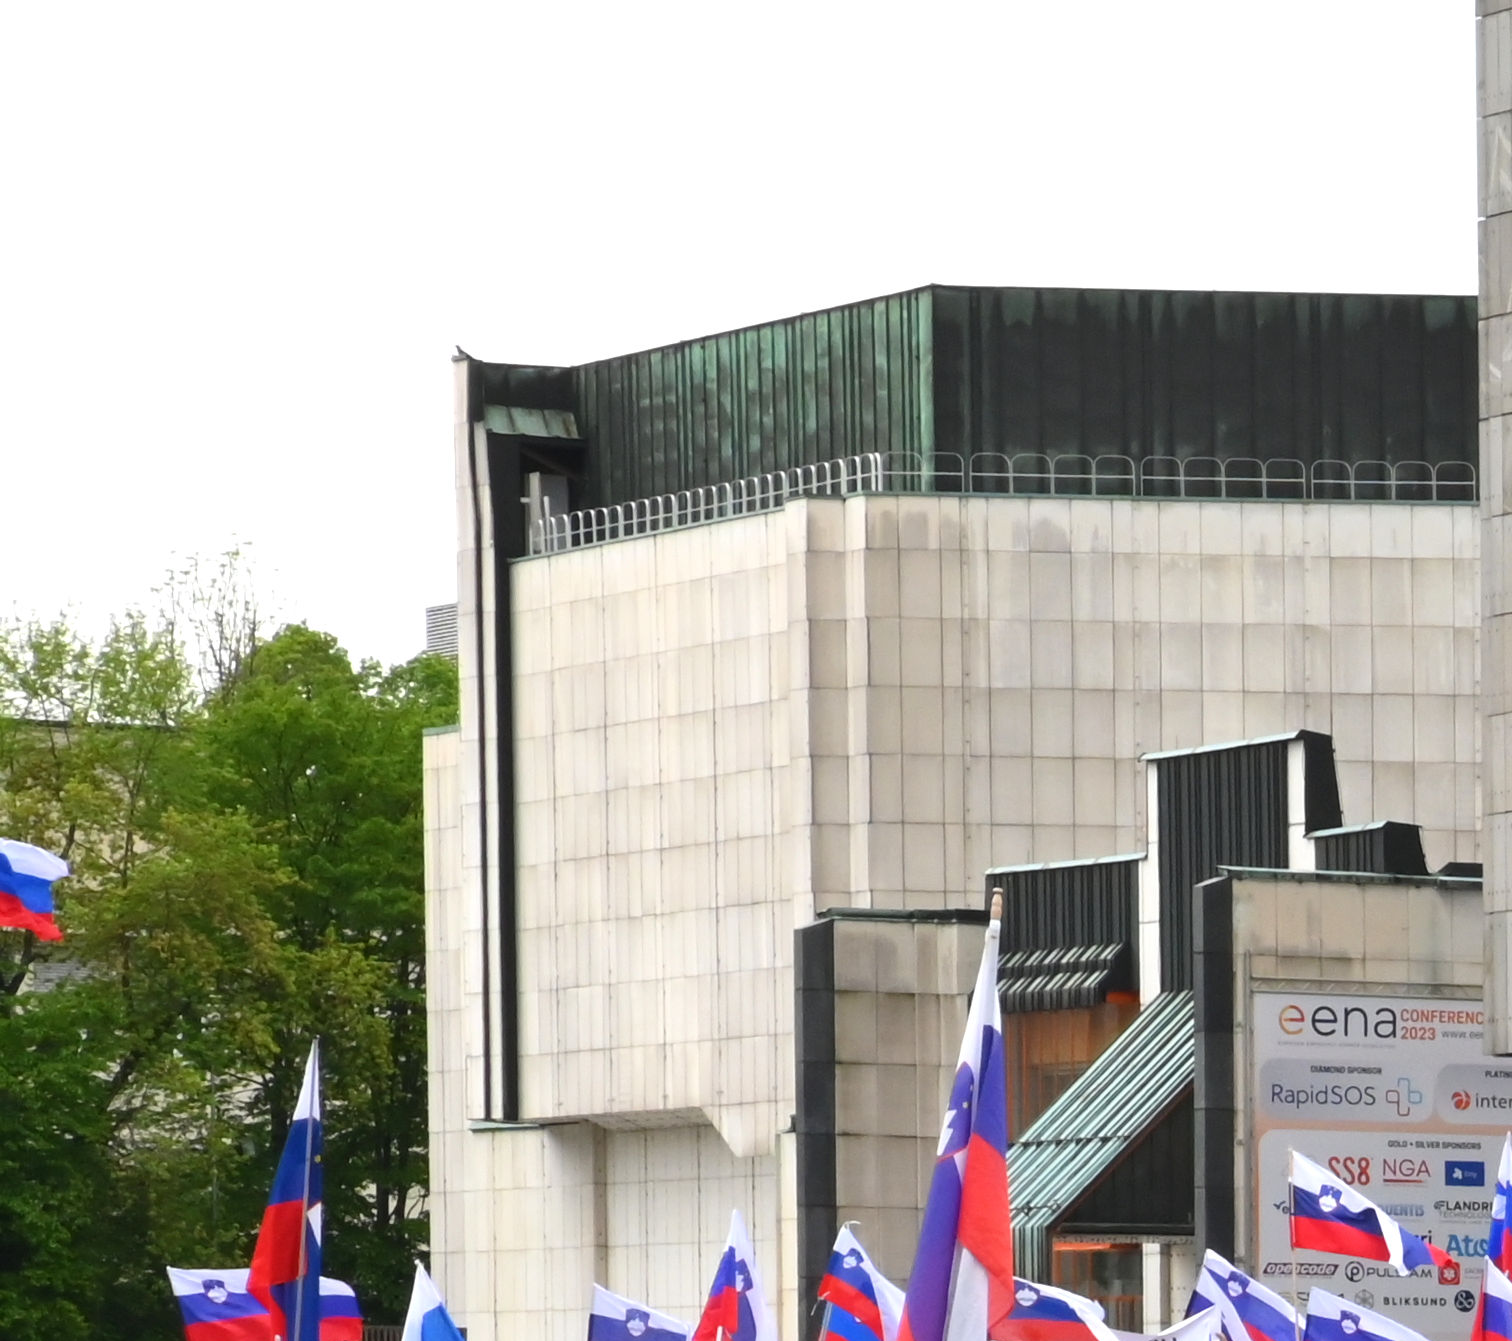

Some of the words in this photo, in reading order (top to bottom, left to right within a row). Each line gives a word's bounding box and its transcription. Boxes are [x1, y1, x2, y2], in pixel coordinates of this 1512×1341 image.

[1401, 1008, 1483, 1025] CONFERENC
[1401, 1027, 1436, 1040] 2023
[1310, 1065, 1345, 1074] DIAMOND
[1346, 1066, 1382, 1075] SPONSOR
[1271, 1084, 1376, 1109] RapidSOS
[1388, 1140, 1407, 1148] GOLD
[1415, 1141, 1440, 1149] SILVER
[1442, 1142, 1482, 1150] SPONSORS
[1328, 1156, 1370, 1186] SS8
[1383, 1159, 1431, 1177] NGA
[1384, 1296, 1448, 1306] BLIKSUND
